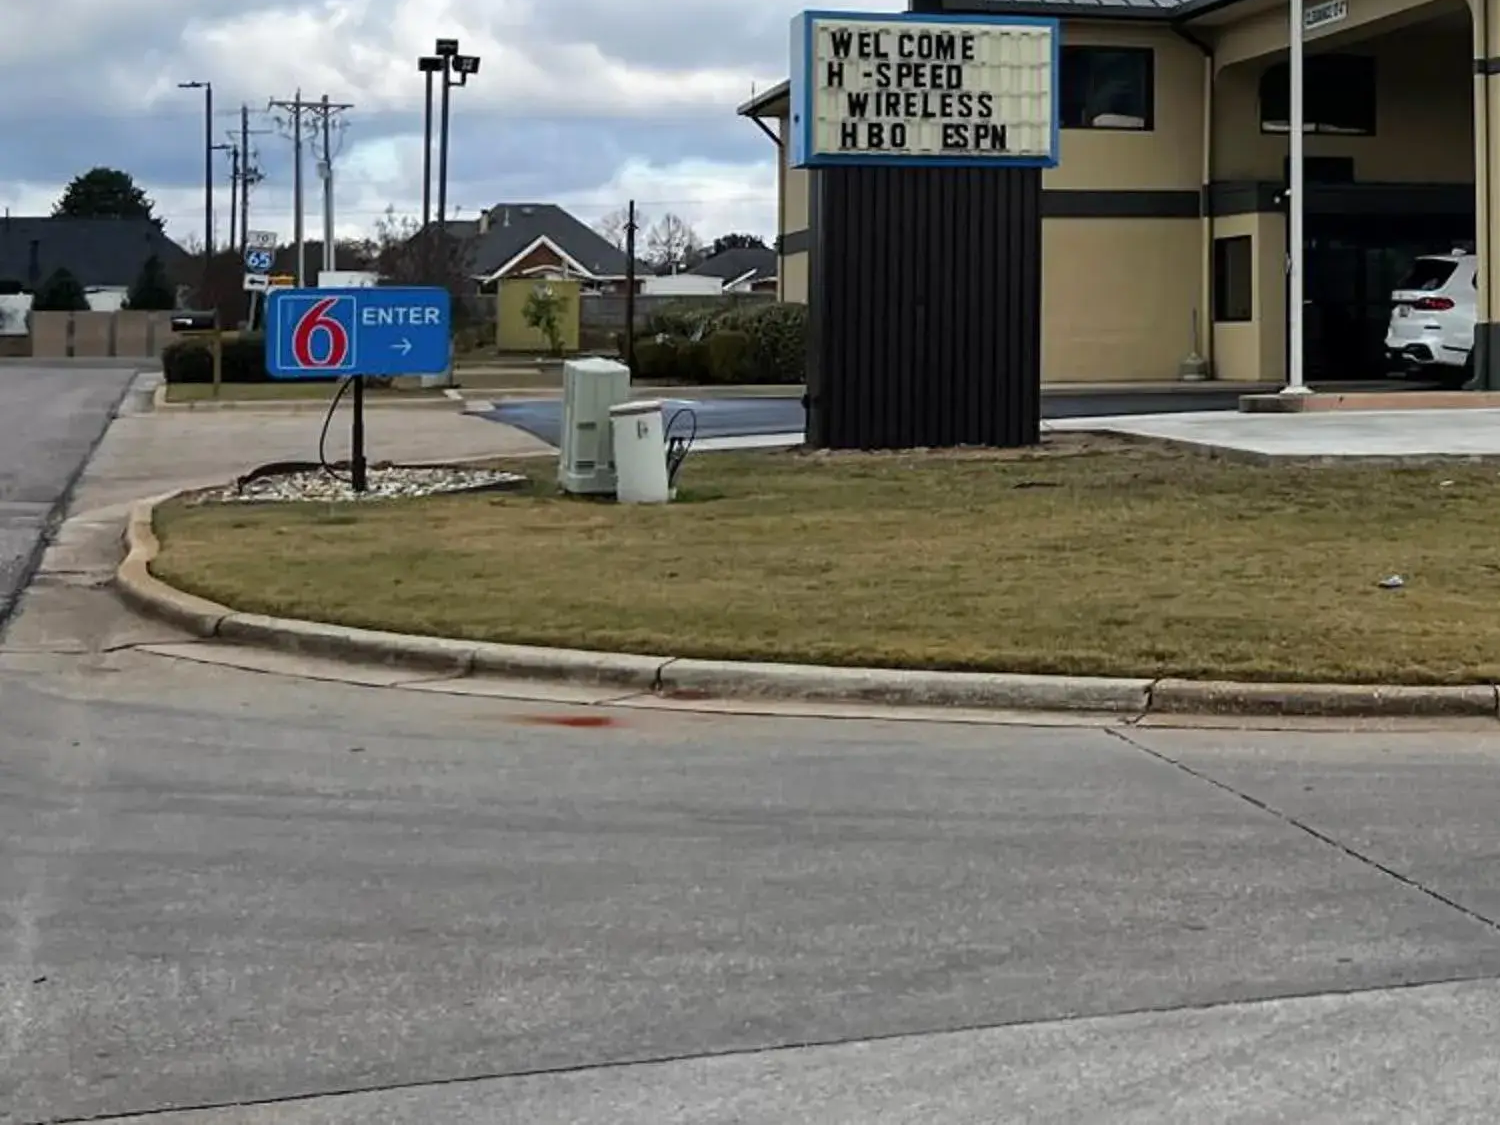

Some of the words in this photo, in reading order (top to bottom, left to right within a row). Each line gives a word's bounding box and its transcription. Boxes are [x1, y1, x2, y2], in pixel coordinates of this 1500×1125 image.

[830, 31, 975, 60] WELCOME
[847, 91, 993, 118] WIRELESS
[841, 122, 907, 149] HBO
[942, 124, 1007, 150] ESPN
[248, 251, 271, 267] 65
[292, 296, 349, 369] 6
[362, 306, 441, 325] ENTER
